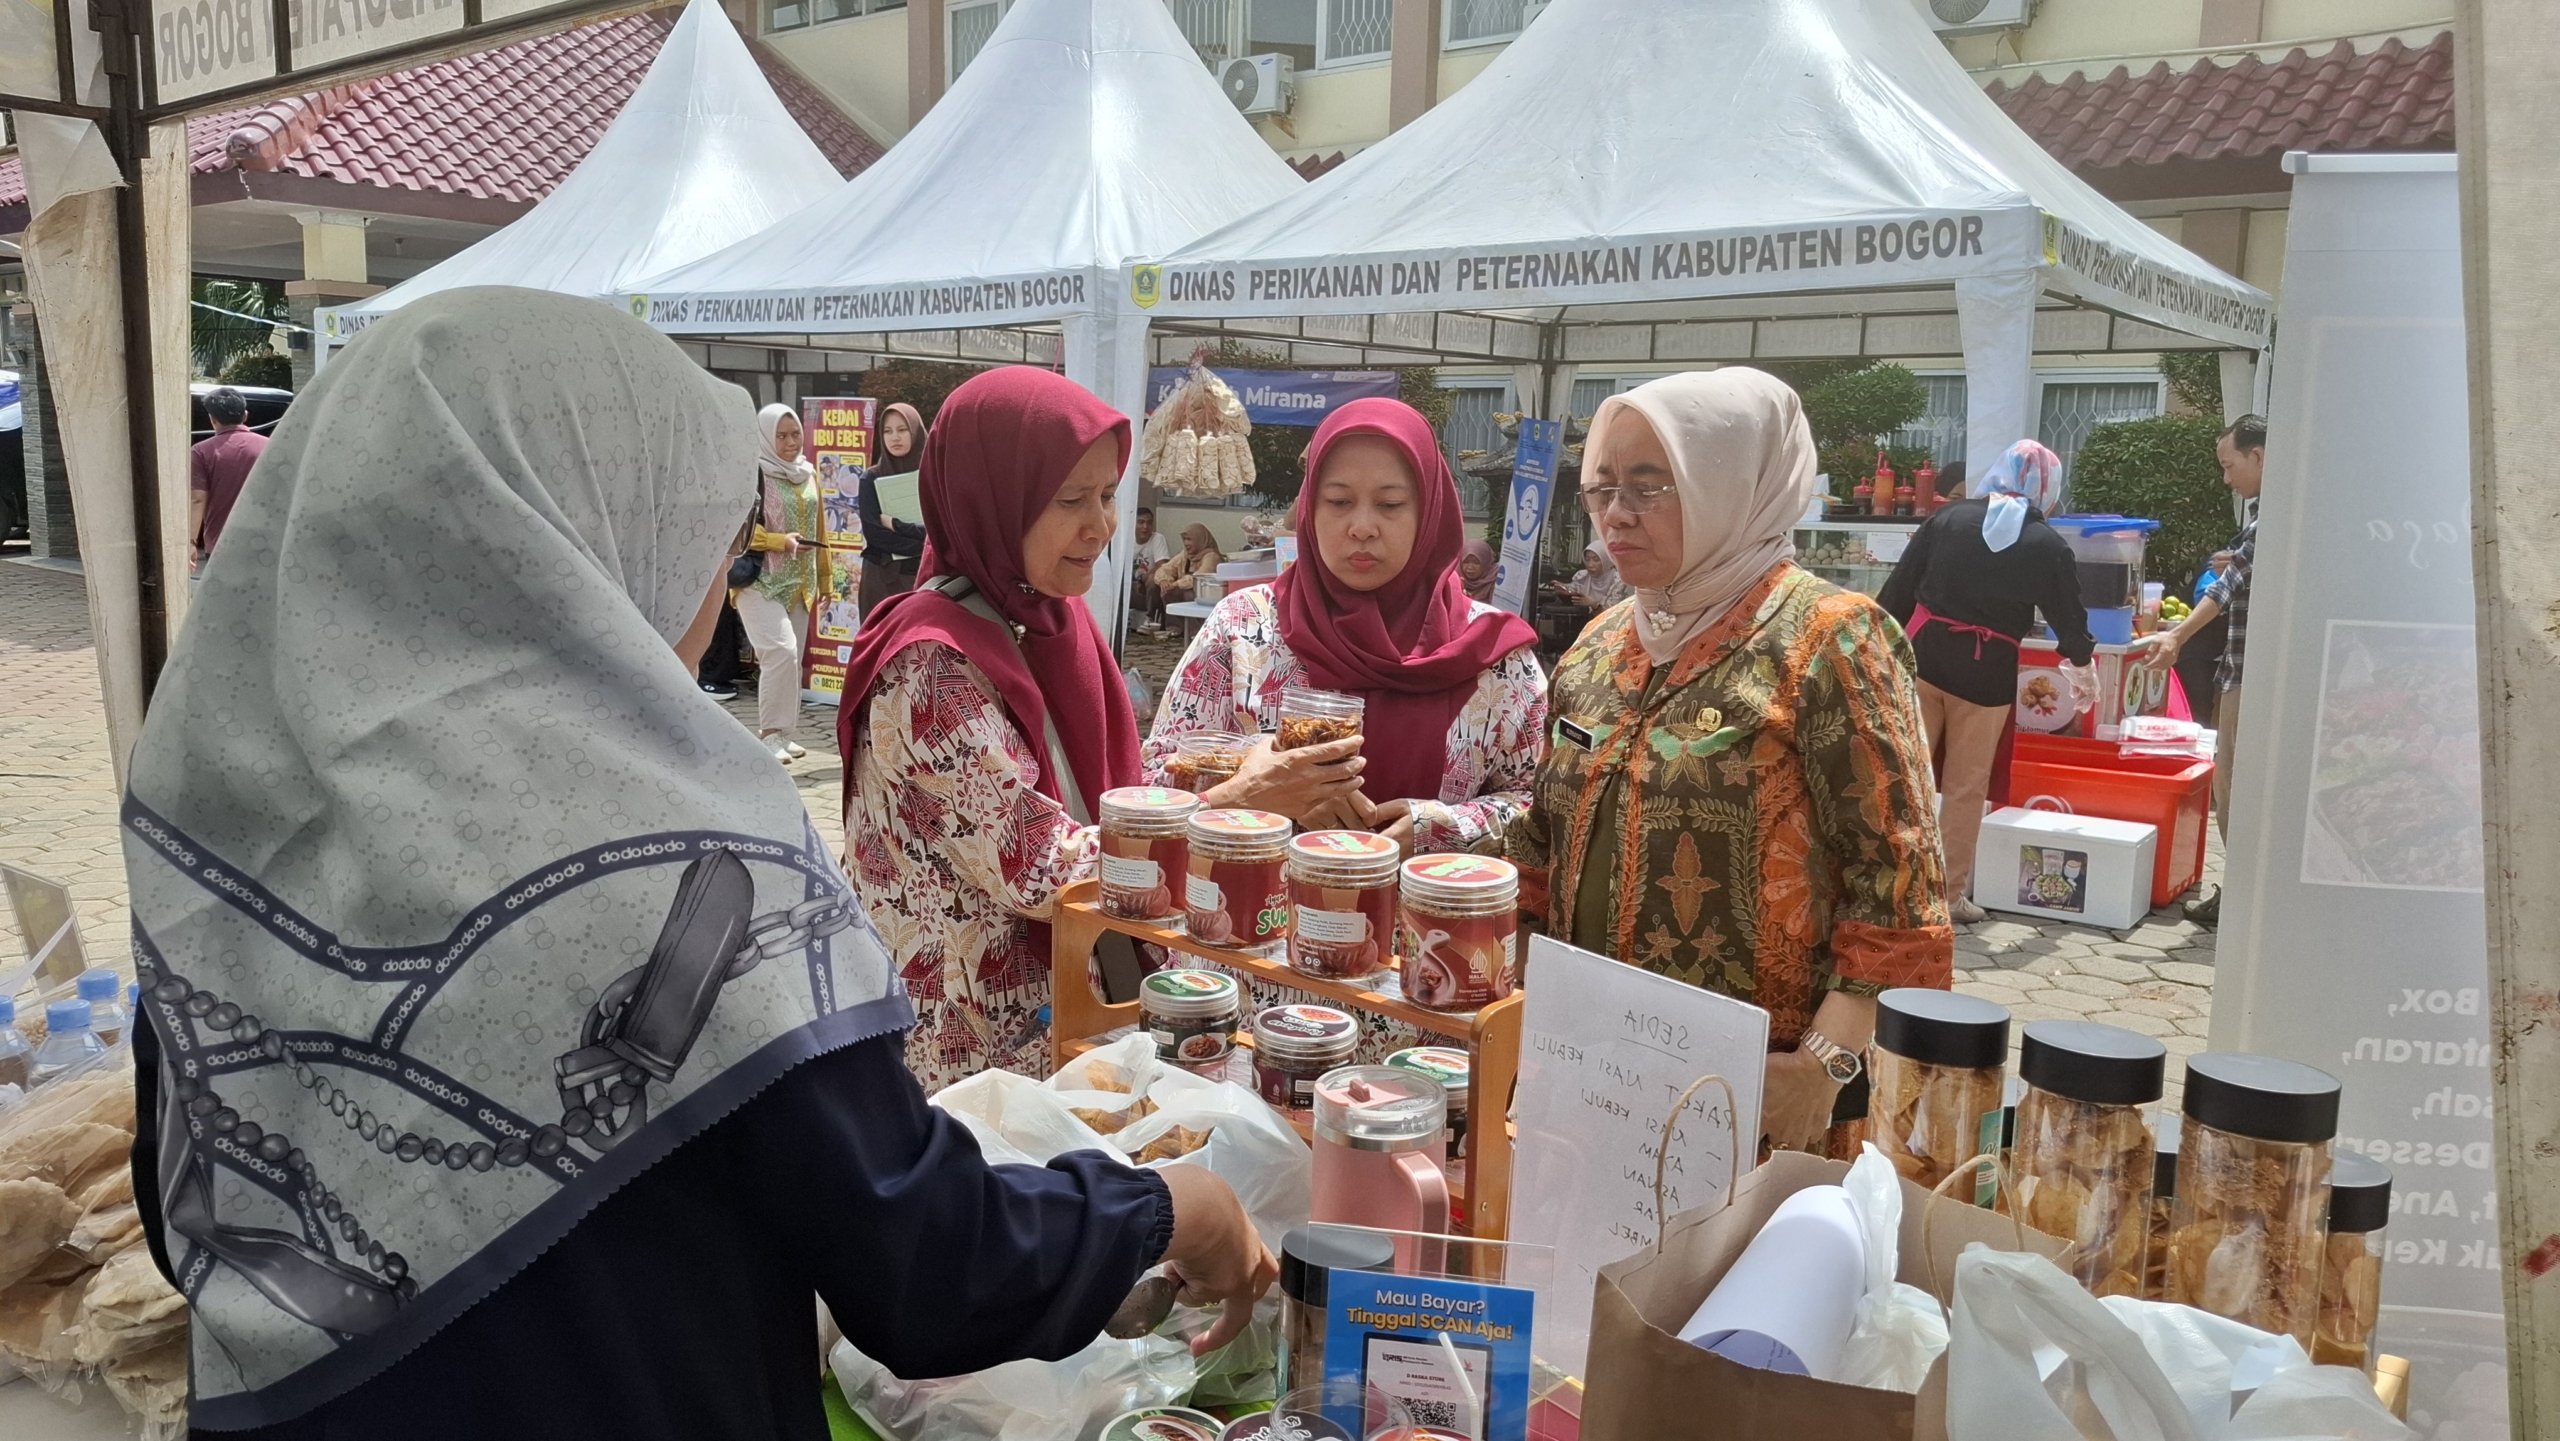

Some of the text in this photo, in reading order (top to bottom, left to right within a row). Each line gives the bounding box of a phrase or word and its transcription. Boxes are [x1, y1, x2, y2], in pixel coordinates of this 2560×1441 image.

[1170, 215, 1984, 301] DINAS PERIKANAN DAN PETERNAKAN KABUPATEN BOGOR
[2061, 225, 2091, 275] DINAS
[650, 274, 1085, 323] DINAS PERIKANAN DAN PETERNAKAN KABUPATEN BOGOR
[340, 315, 365, 335] DINAS
[1246, 386, 1326, 409] Mirama
[823, 409, 859, 427] KEDAI
[813, 429, 866, 448] IBU EBET
[1376, 1289, 1487, 1315] Mau Bayar?
[1347, 1307, 1514, 1342] Tinggal SCAN Aja!
